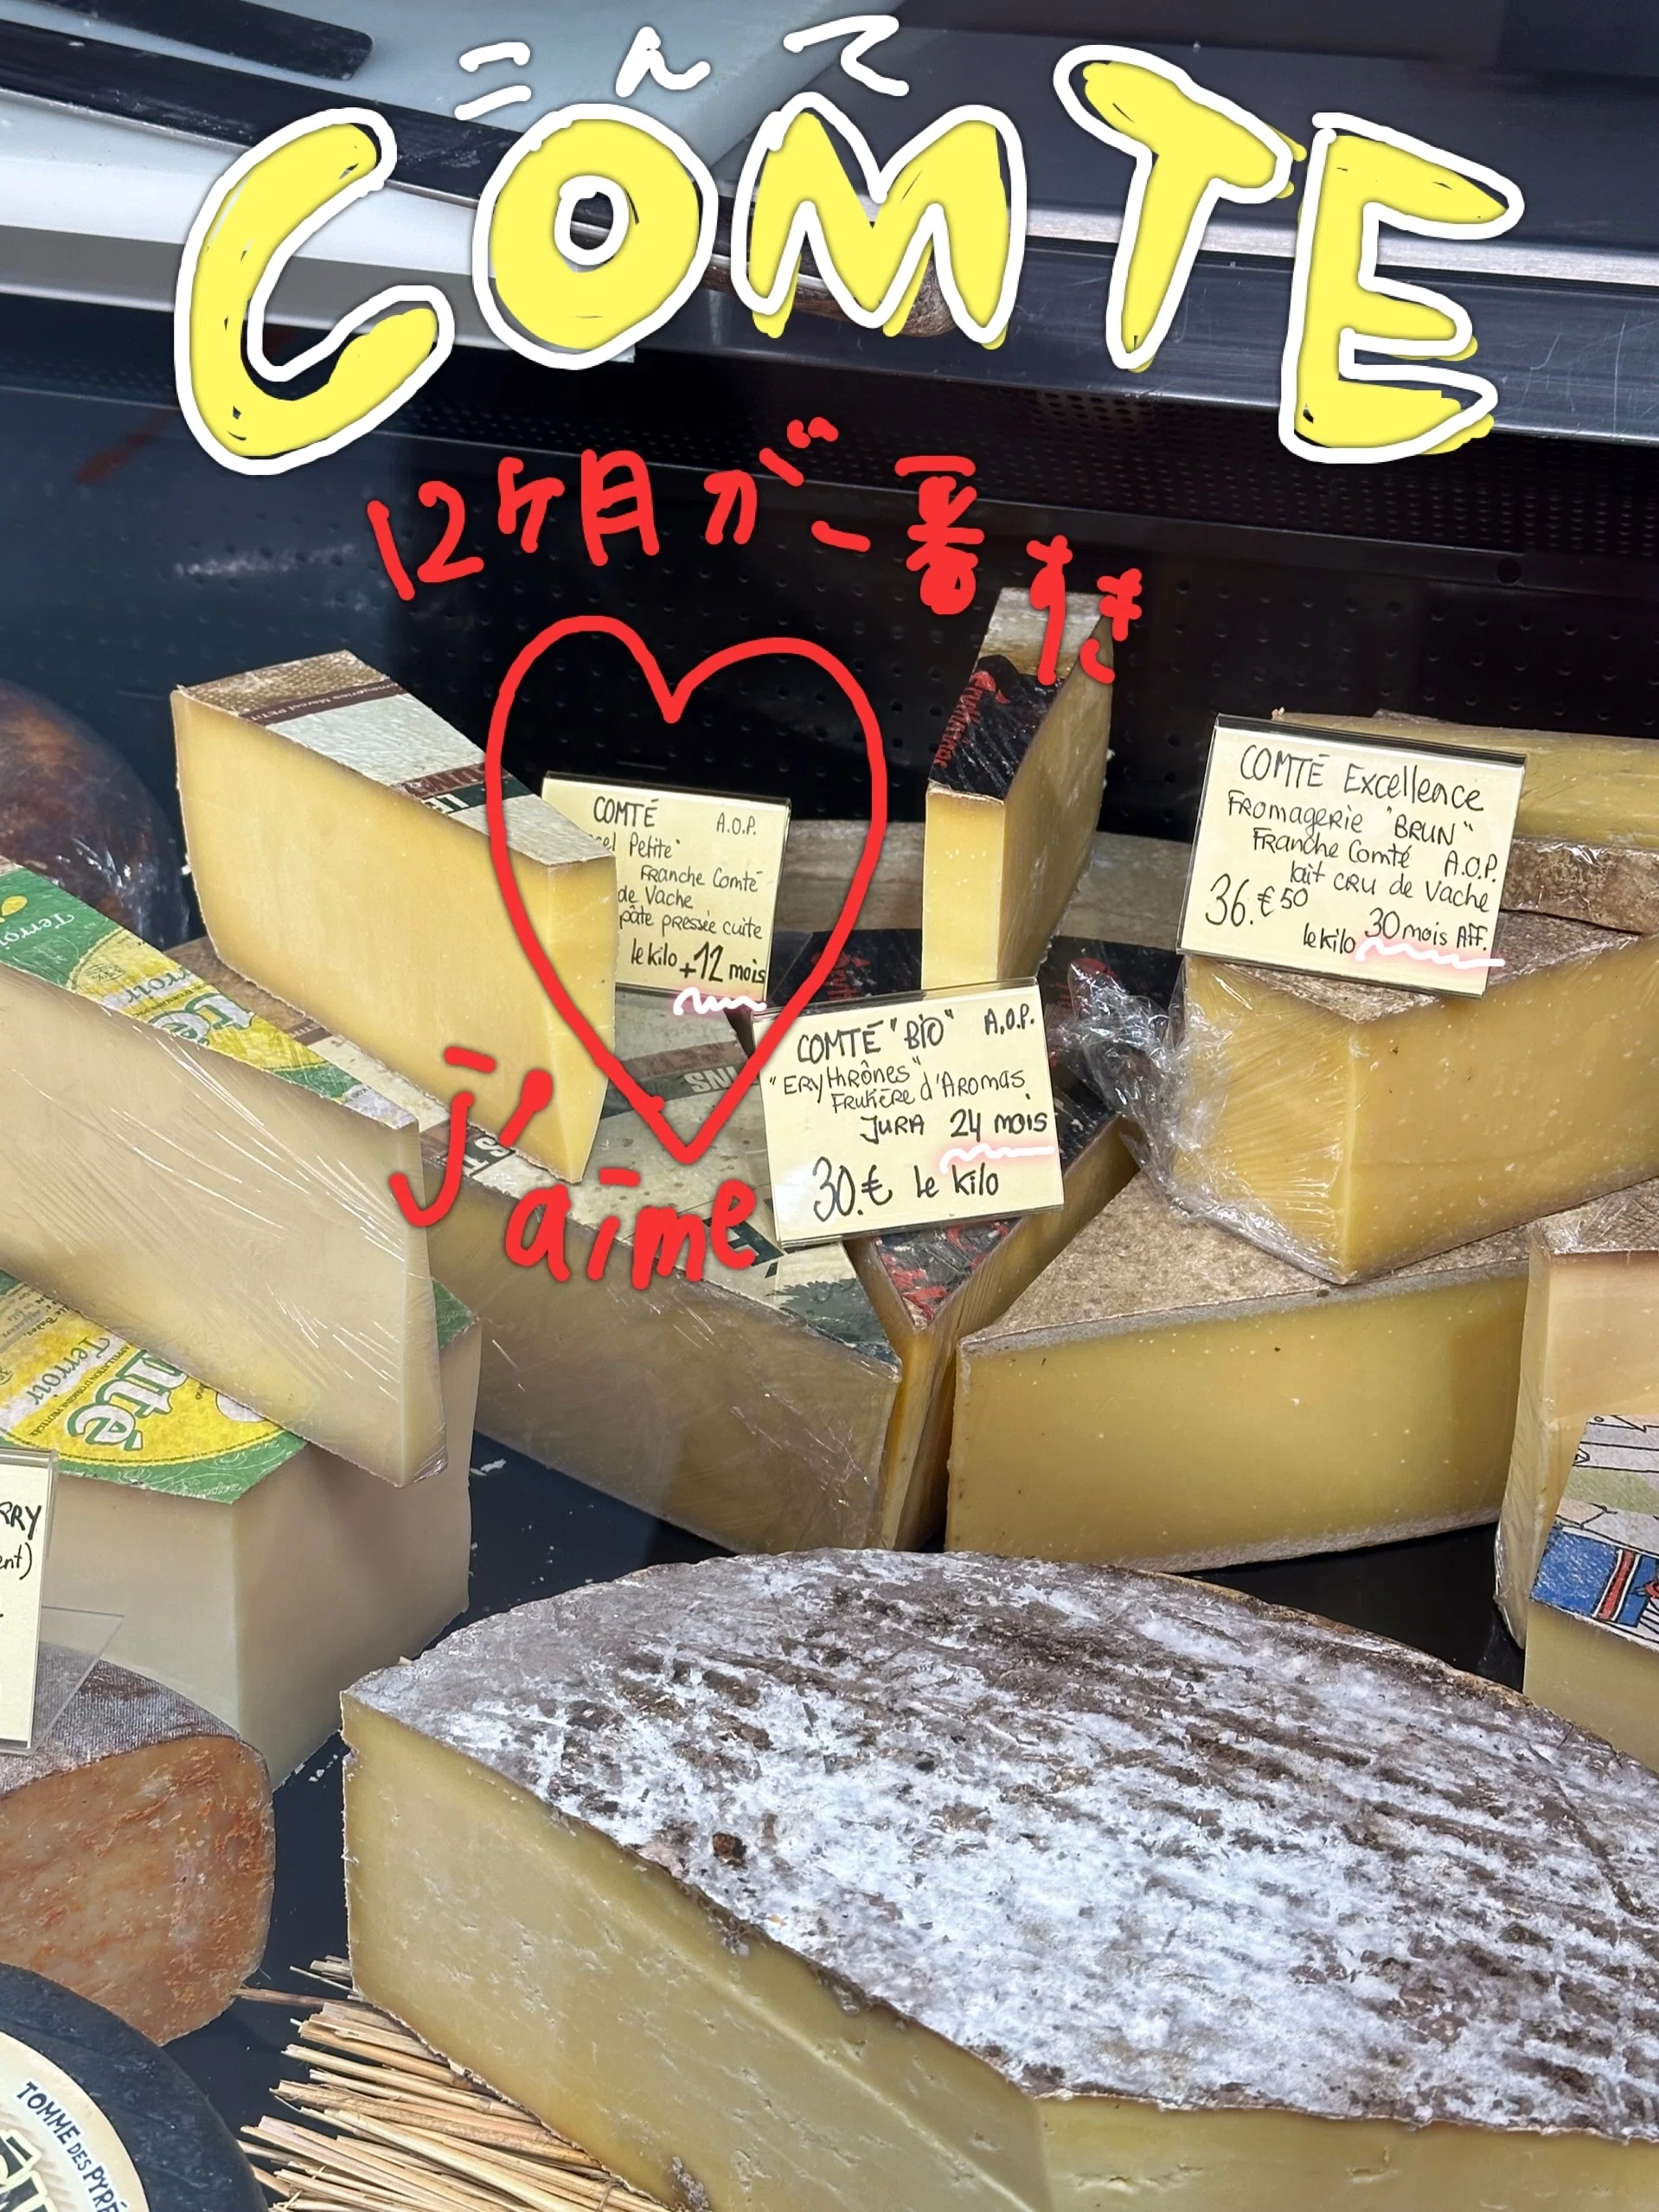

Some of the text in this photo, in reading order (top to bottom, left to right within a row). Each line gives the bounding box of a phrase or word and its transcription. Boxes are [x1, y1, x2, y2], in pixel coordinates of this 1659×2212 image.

[1344, 763, 1484, 811] Excellence
[1348, 838, 1412, 869] Comté
[713, 868, 763, 893] Comté
[1390, 875, 1413, 898] de
[0, 913, 75, 949] Terroi
[619, 906, 653, 929] pâte
[723, 917, 763, 939] cuite
[1365, 907, 1401, 939] 30
[1402, 922, 1449, 947] mois
[126, 966, 192, 1003] rroir
[729, 959, 766, 984] mois
[950, 1109, 982, 1142] 24
[26, 1337, 111, 1406] Terroir
[0, 1501, 42, 1541] RRY
[16, 2081, 81, 2145] TOMME
[67, 2142, 93, 2171] DES
[82, 2164, 128, 2212] PYRÉ
